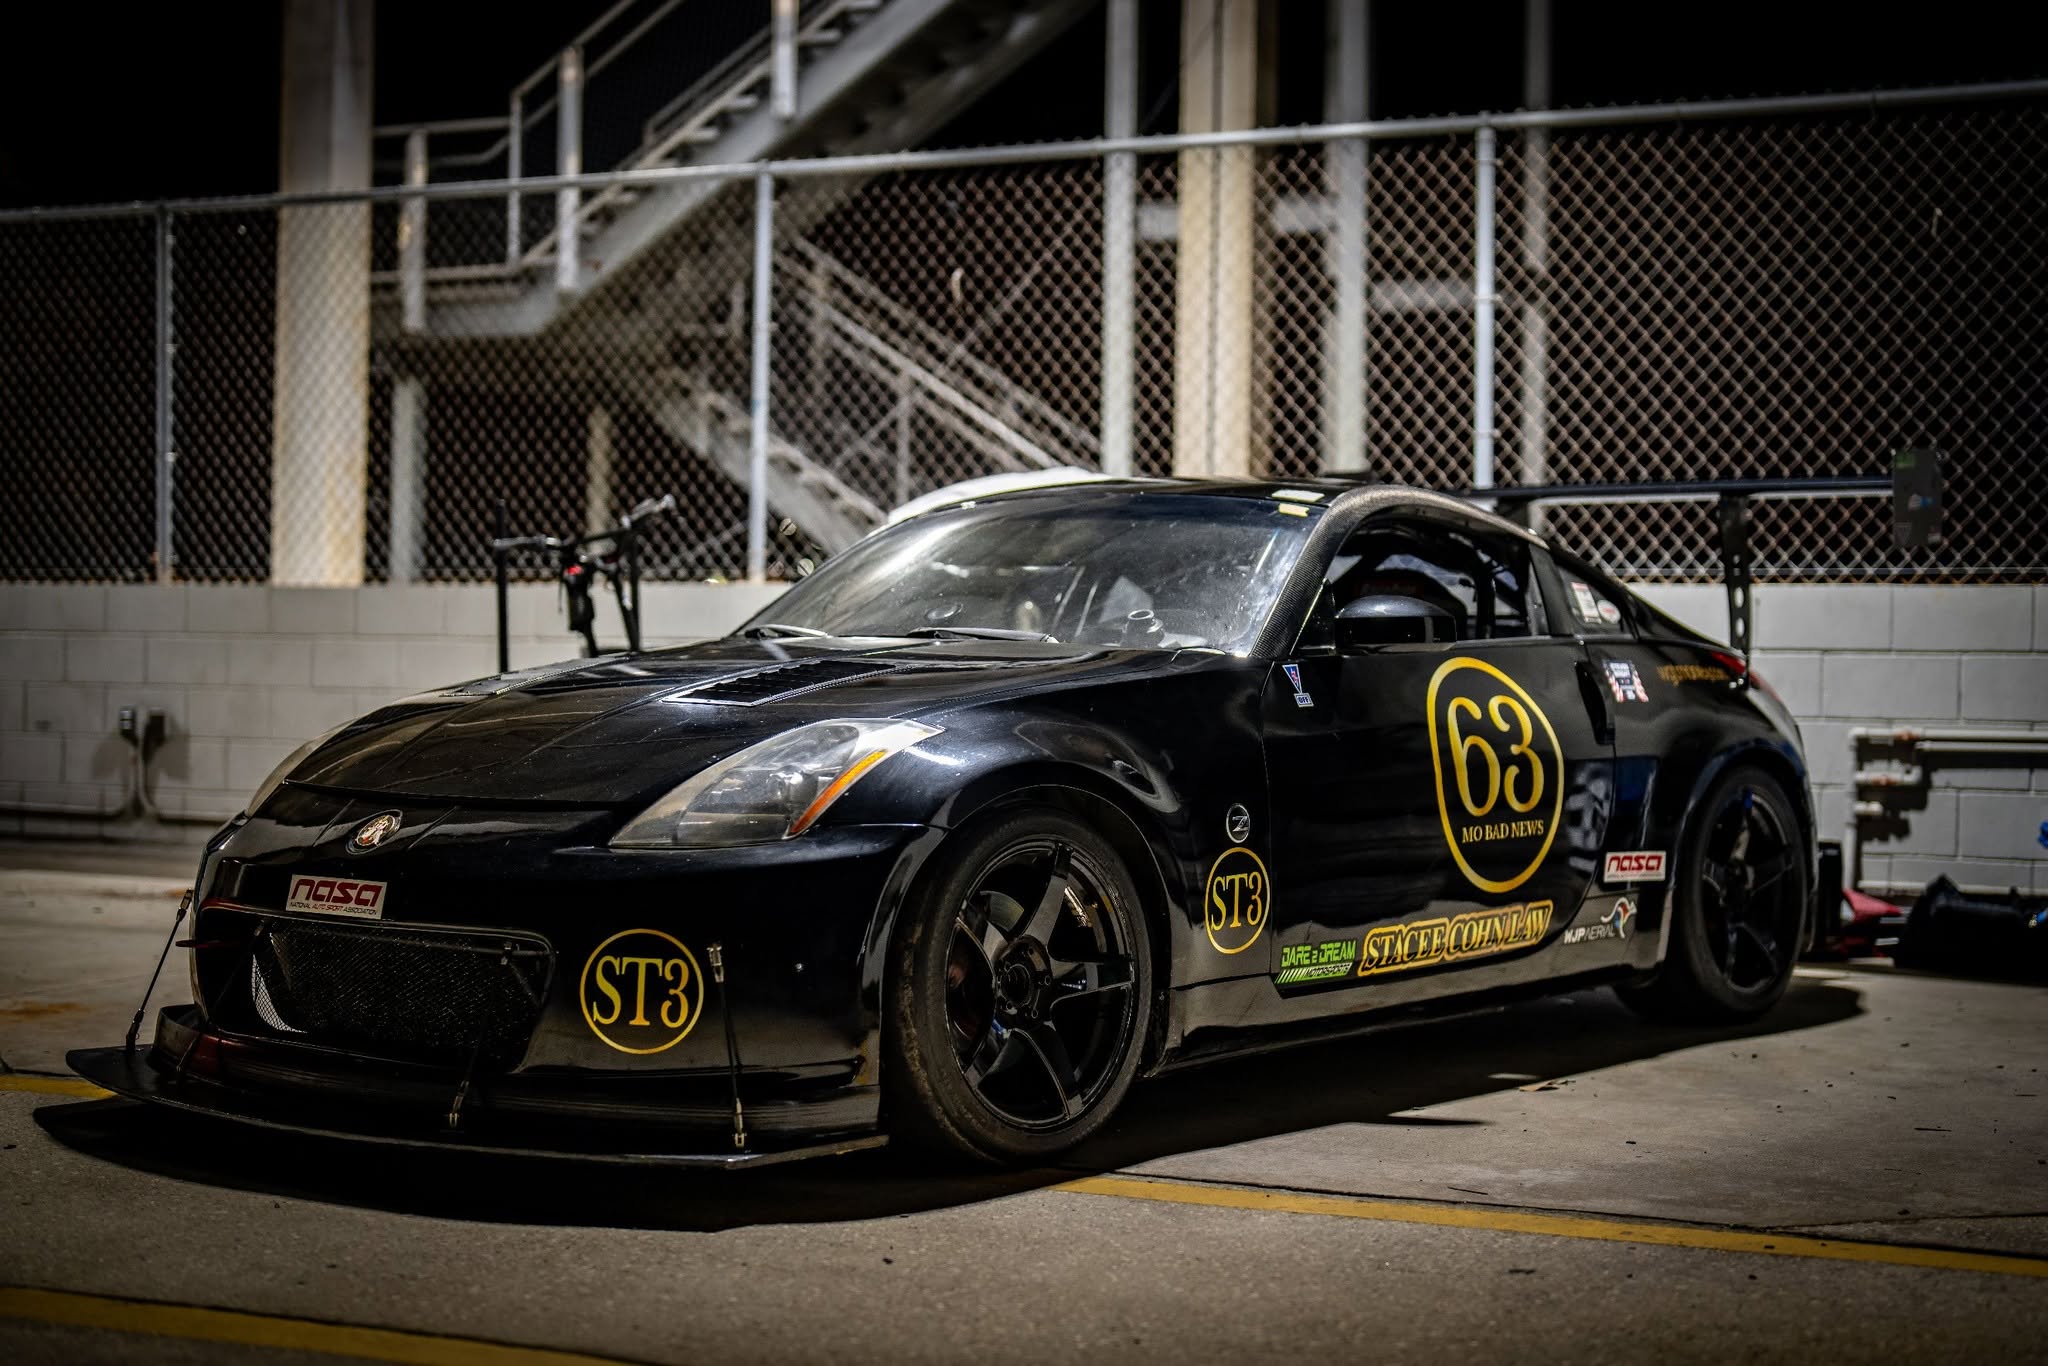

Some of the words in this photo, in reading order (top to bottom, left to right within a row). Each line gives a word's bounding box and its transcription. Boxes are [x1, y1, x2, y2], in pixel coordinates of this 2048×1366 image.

[1447, 694, 1545, 817] 63
[1462, 825, 1483, 843] MO
[1485, 822, 1510, 841] BAD
[1511, 819, 1545, 838] NEWS
[1211, 871, 1263, 931] ST3
[1281, 945, 1311, 968] DARE
[1319, 940, 1357, 962] DREAM
[1363, 925, 1447, 971] STACEE
[1449, 914, 1507, 954] COHN
[1507, 908, 1549, 943] LAW
[592, 955, 689, 1029] ST3
